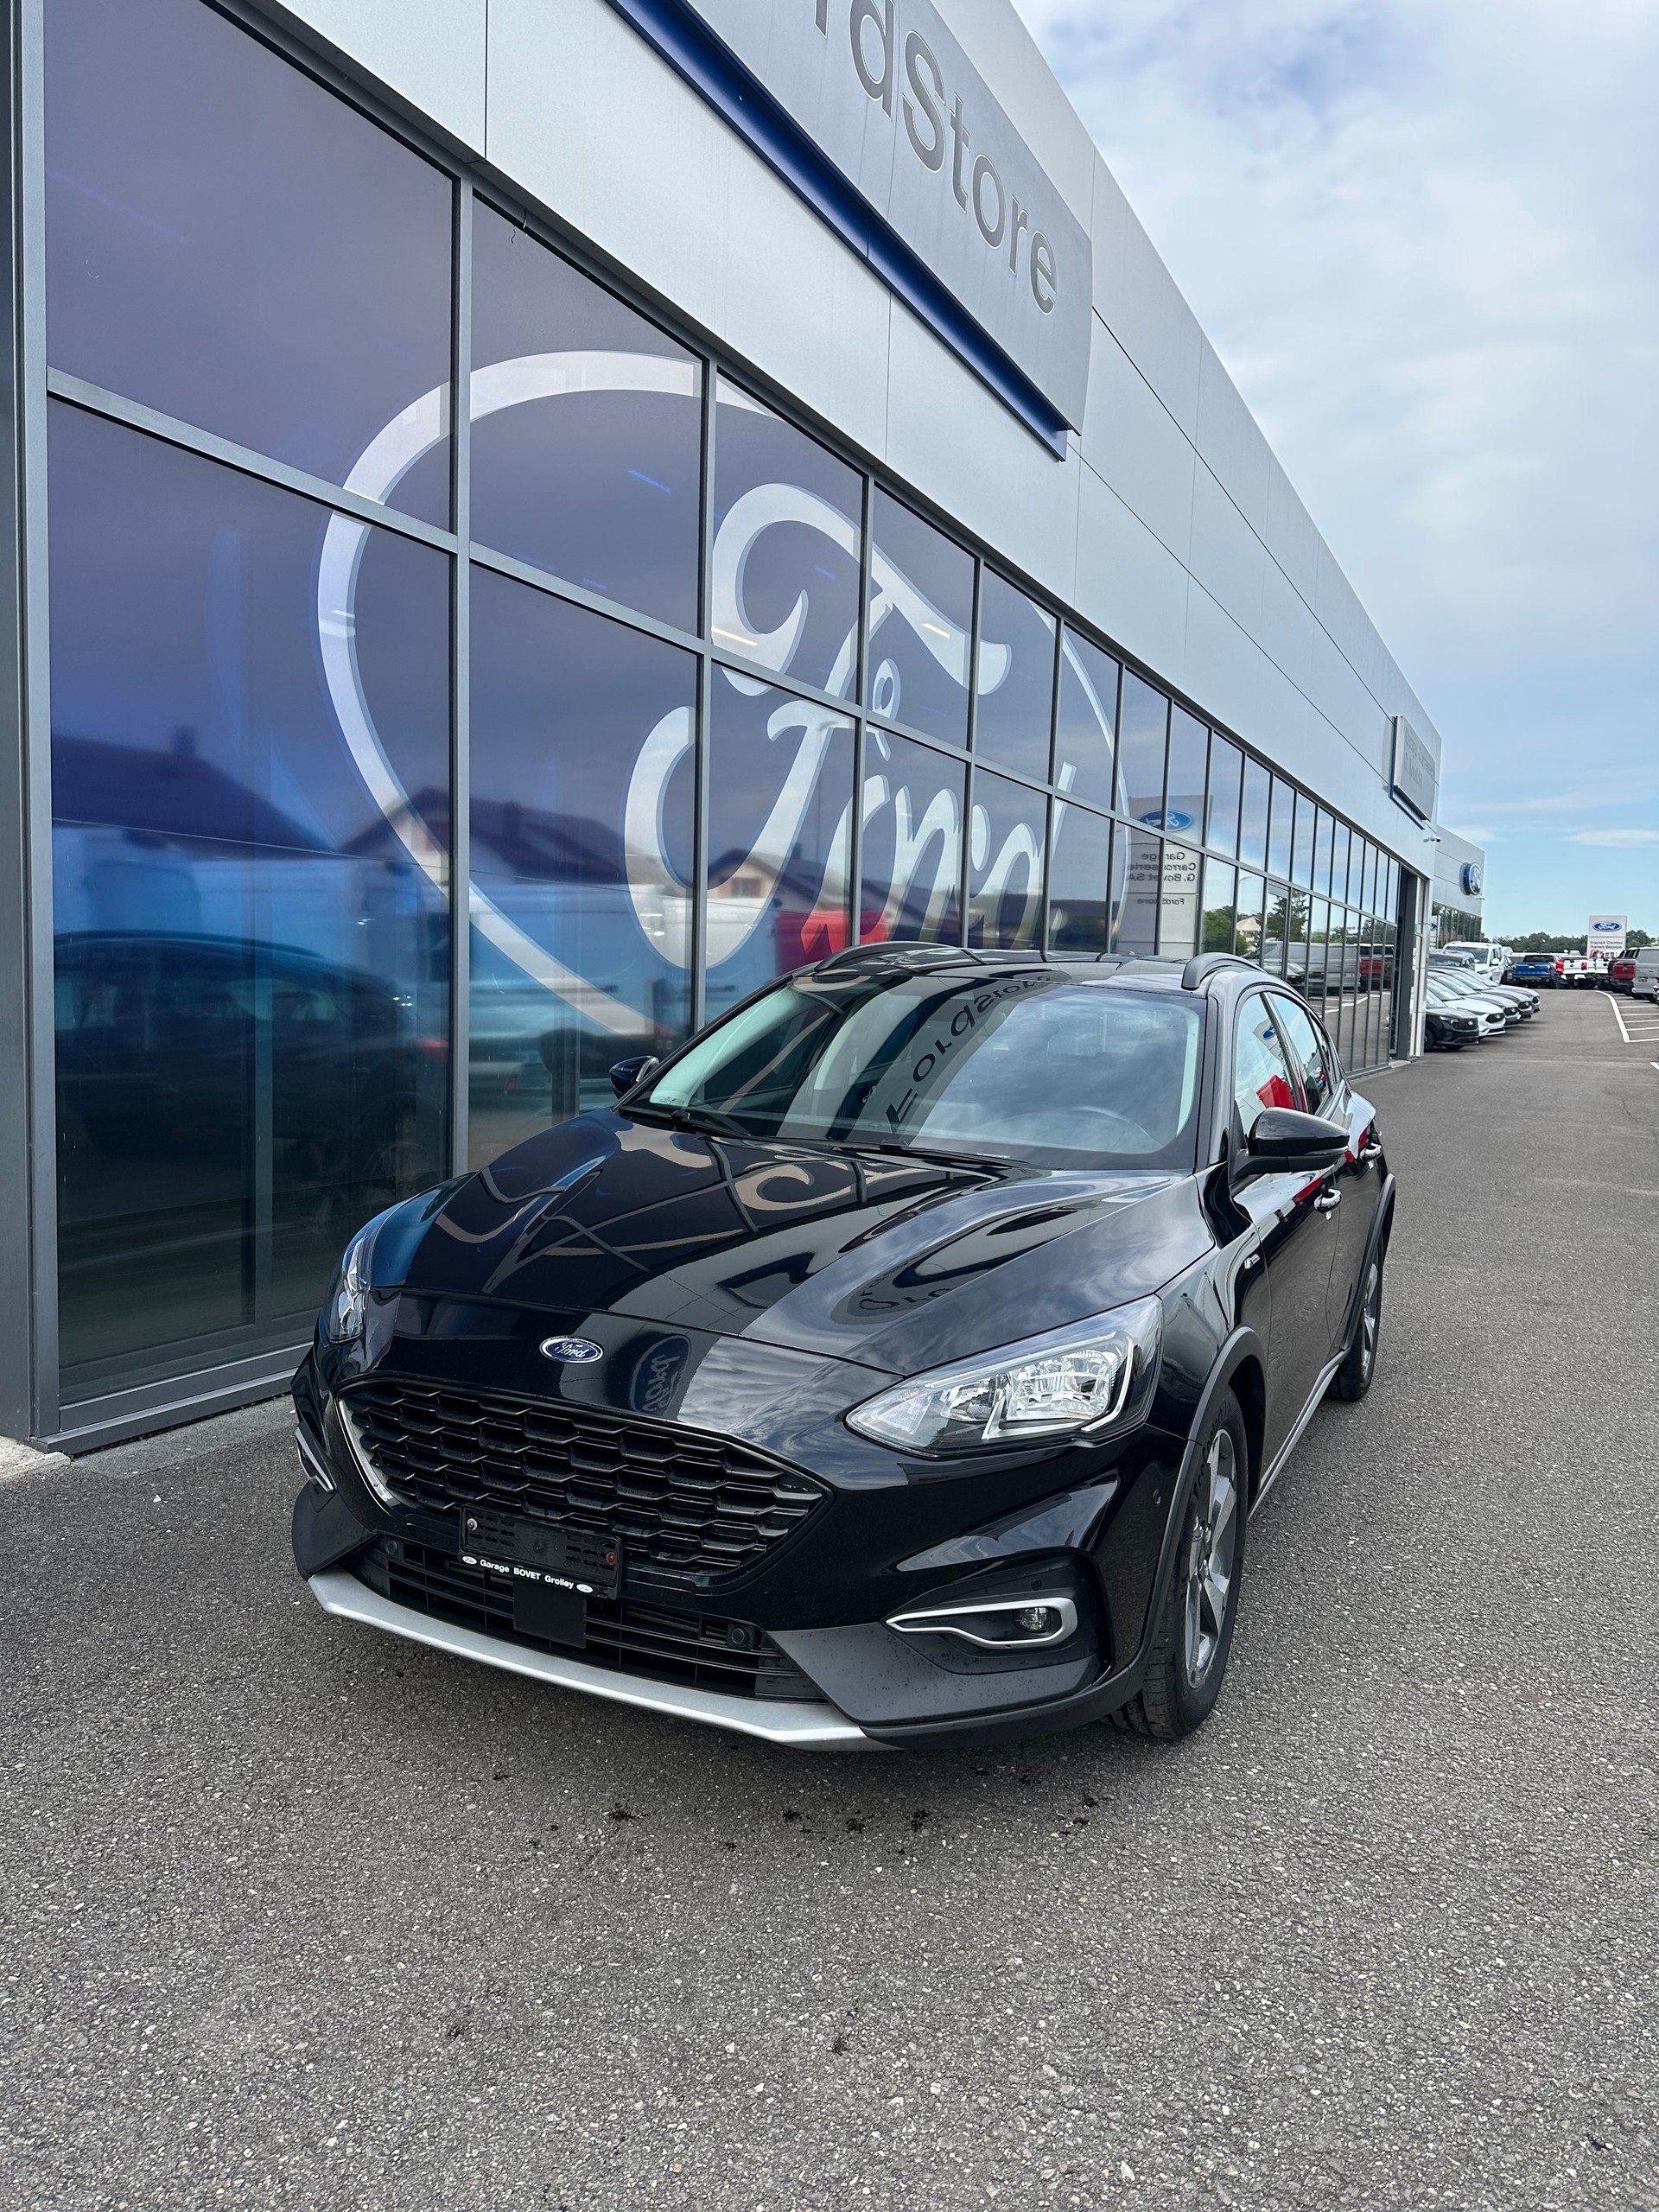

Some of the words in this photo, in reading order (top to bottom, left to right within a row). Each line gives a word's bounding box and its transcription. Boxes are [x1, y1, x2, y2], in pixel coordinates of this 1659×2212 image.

[623, 483, 1077, 970] Ford
[554, 1341, 590, 1358] Ford
[480, 1559, 510, 1573] Garage
[513, 1567, 542, 1580] BOVET
[544, 1575, 575, 1589] Grolley
